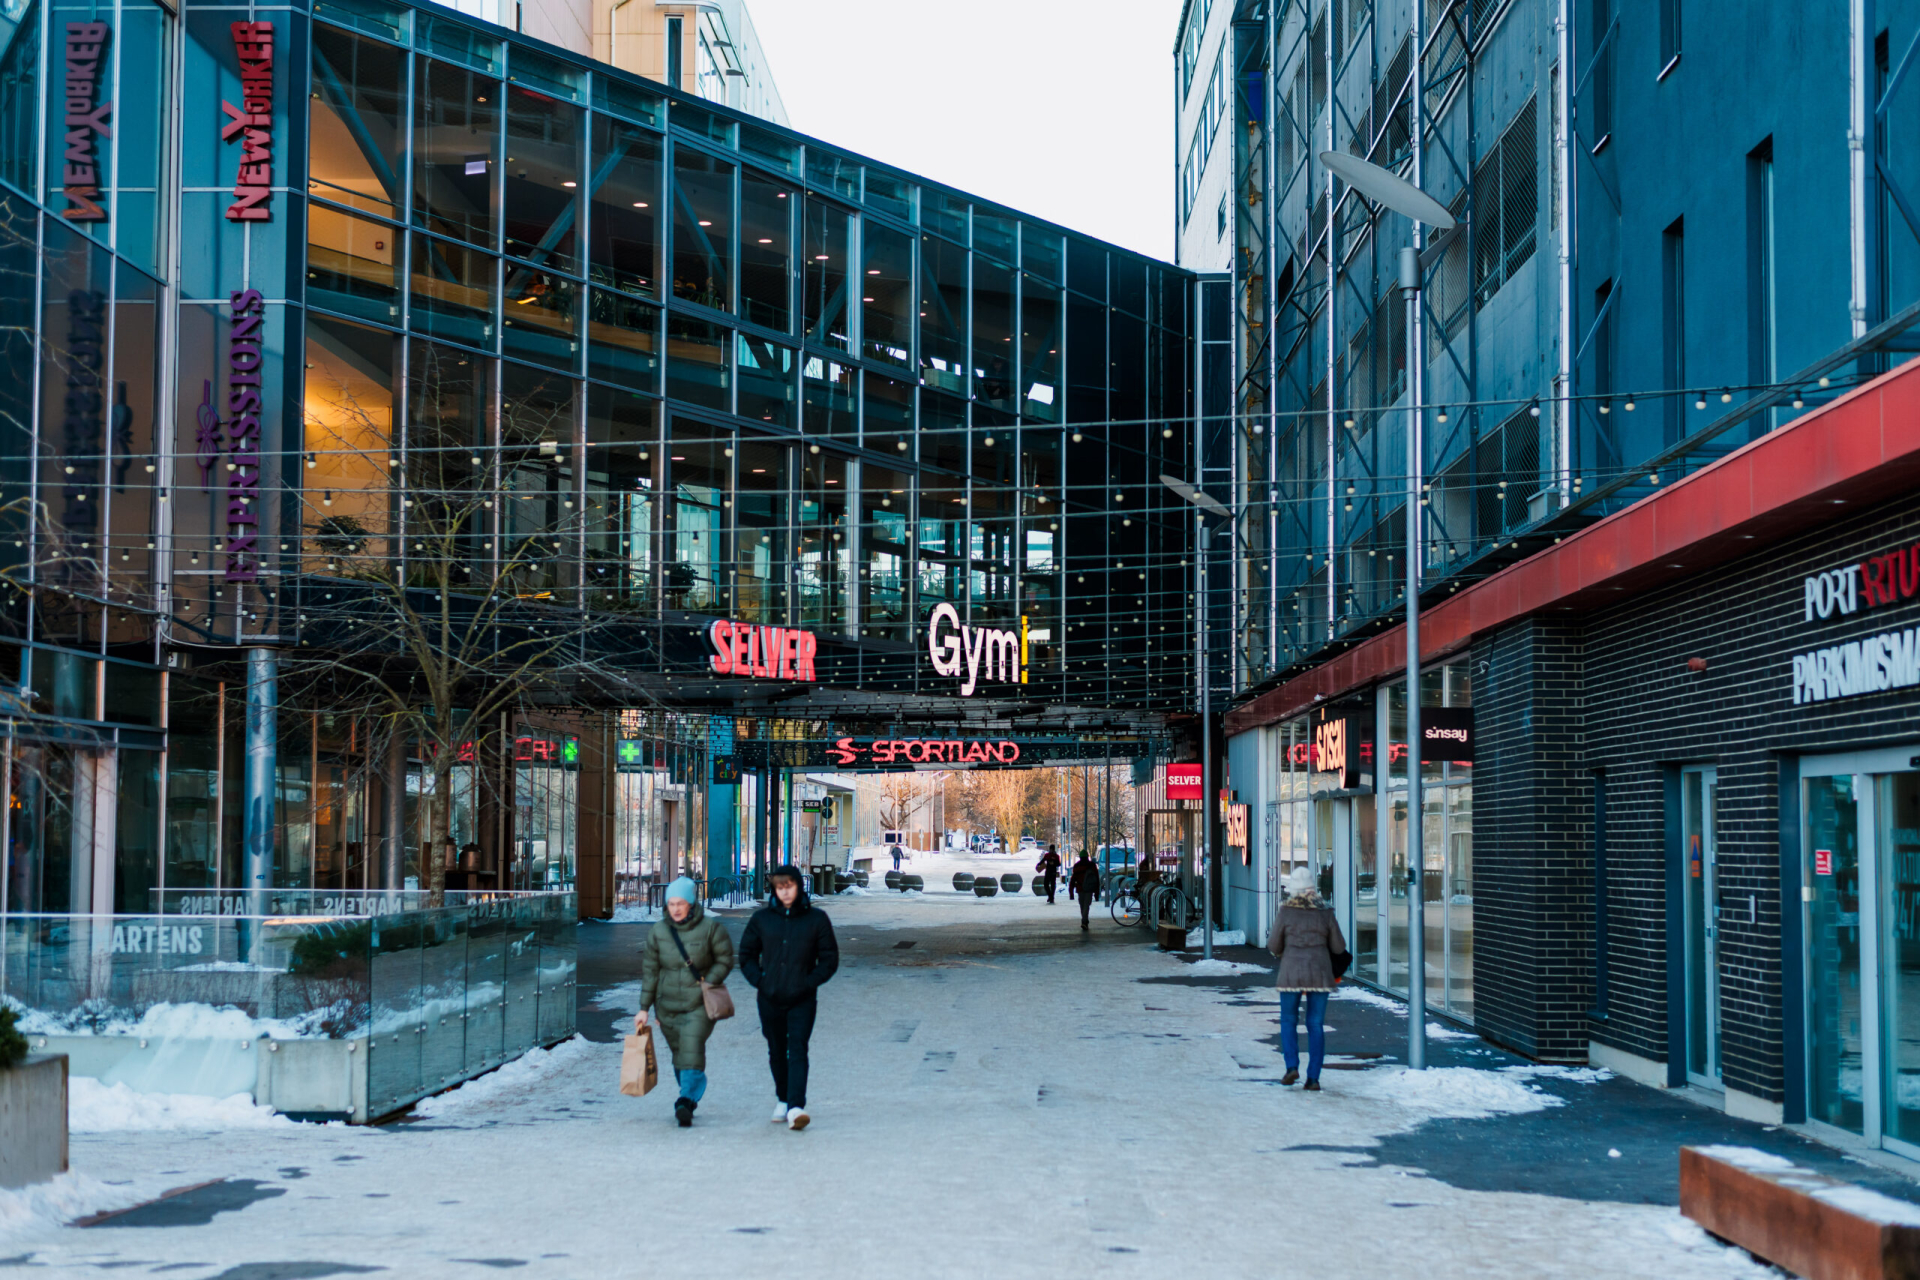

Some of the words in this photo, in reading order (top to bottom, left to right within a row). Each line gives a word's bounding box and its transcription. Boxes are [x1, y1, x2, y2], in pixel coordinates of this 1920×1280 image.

[226, 288, 263, 583] EXPRESSIONS
[709, 619, 817, 682] SELVER
[929, 602, 1029, 696] Gym!
[871, 740, 1020, 763] SPORTLAND
[1316, 708, 1346, 788] sinsay
[1425, 726, 1468, 742] sinsay
[1168, 775, 1201, 785] SELVER
